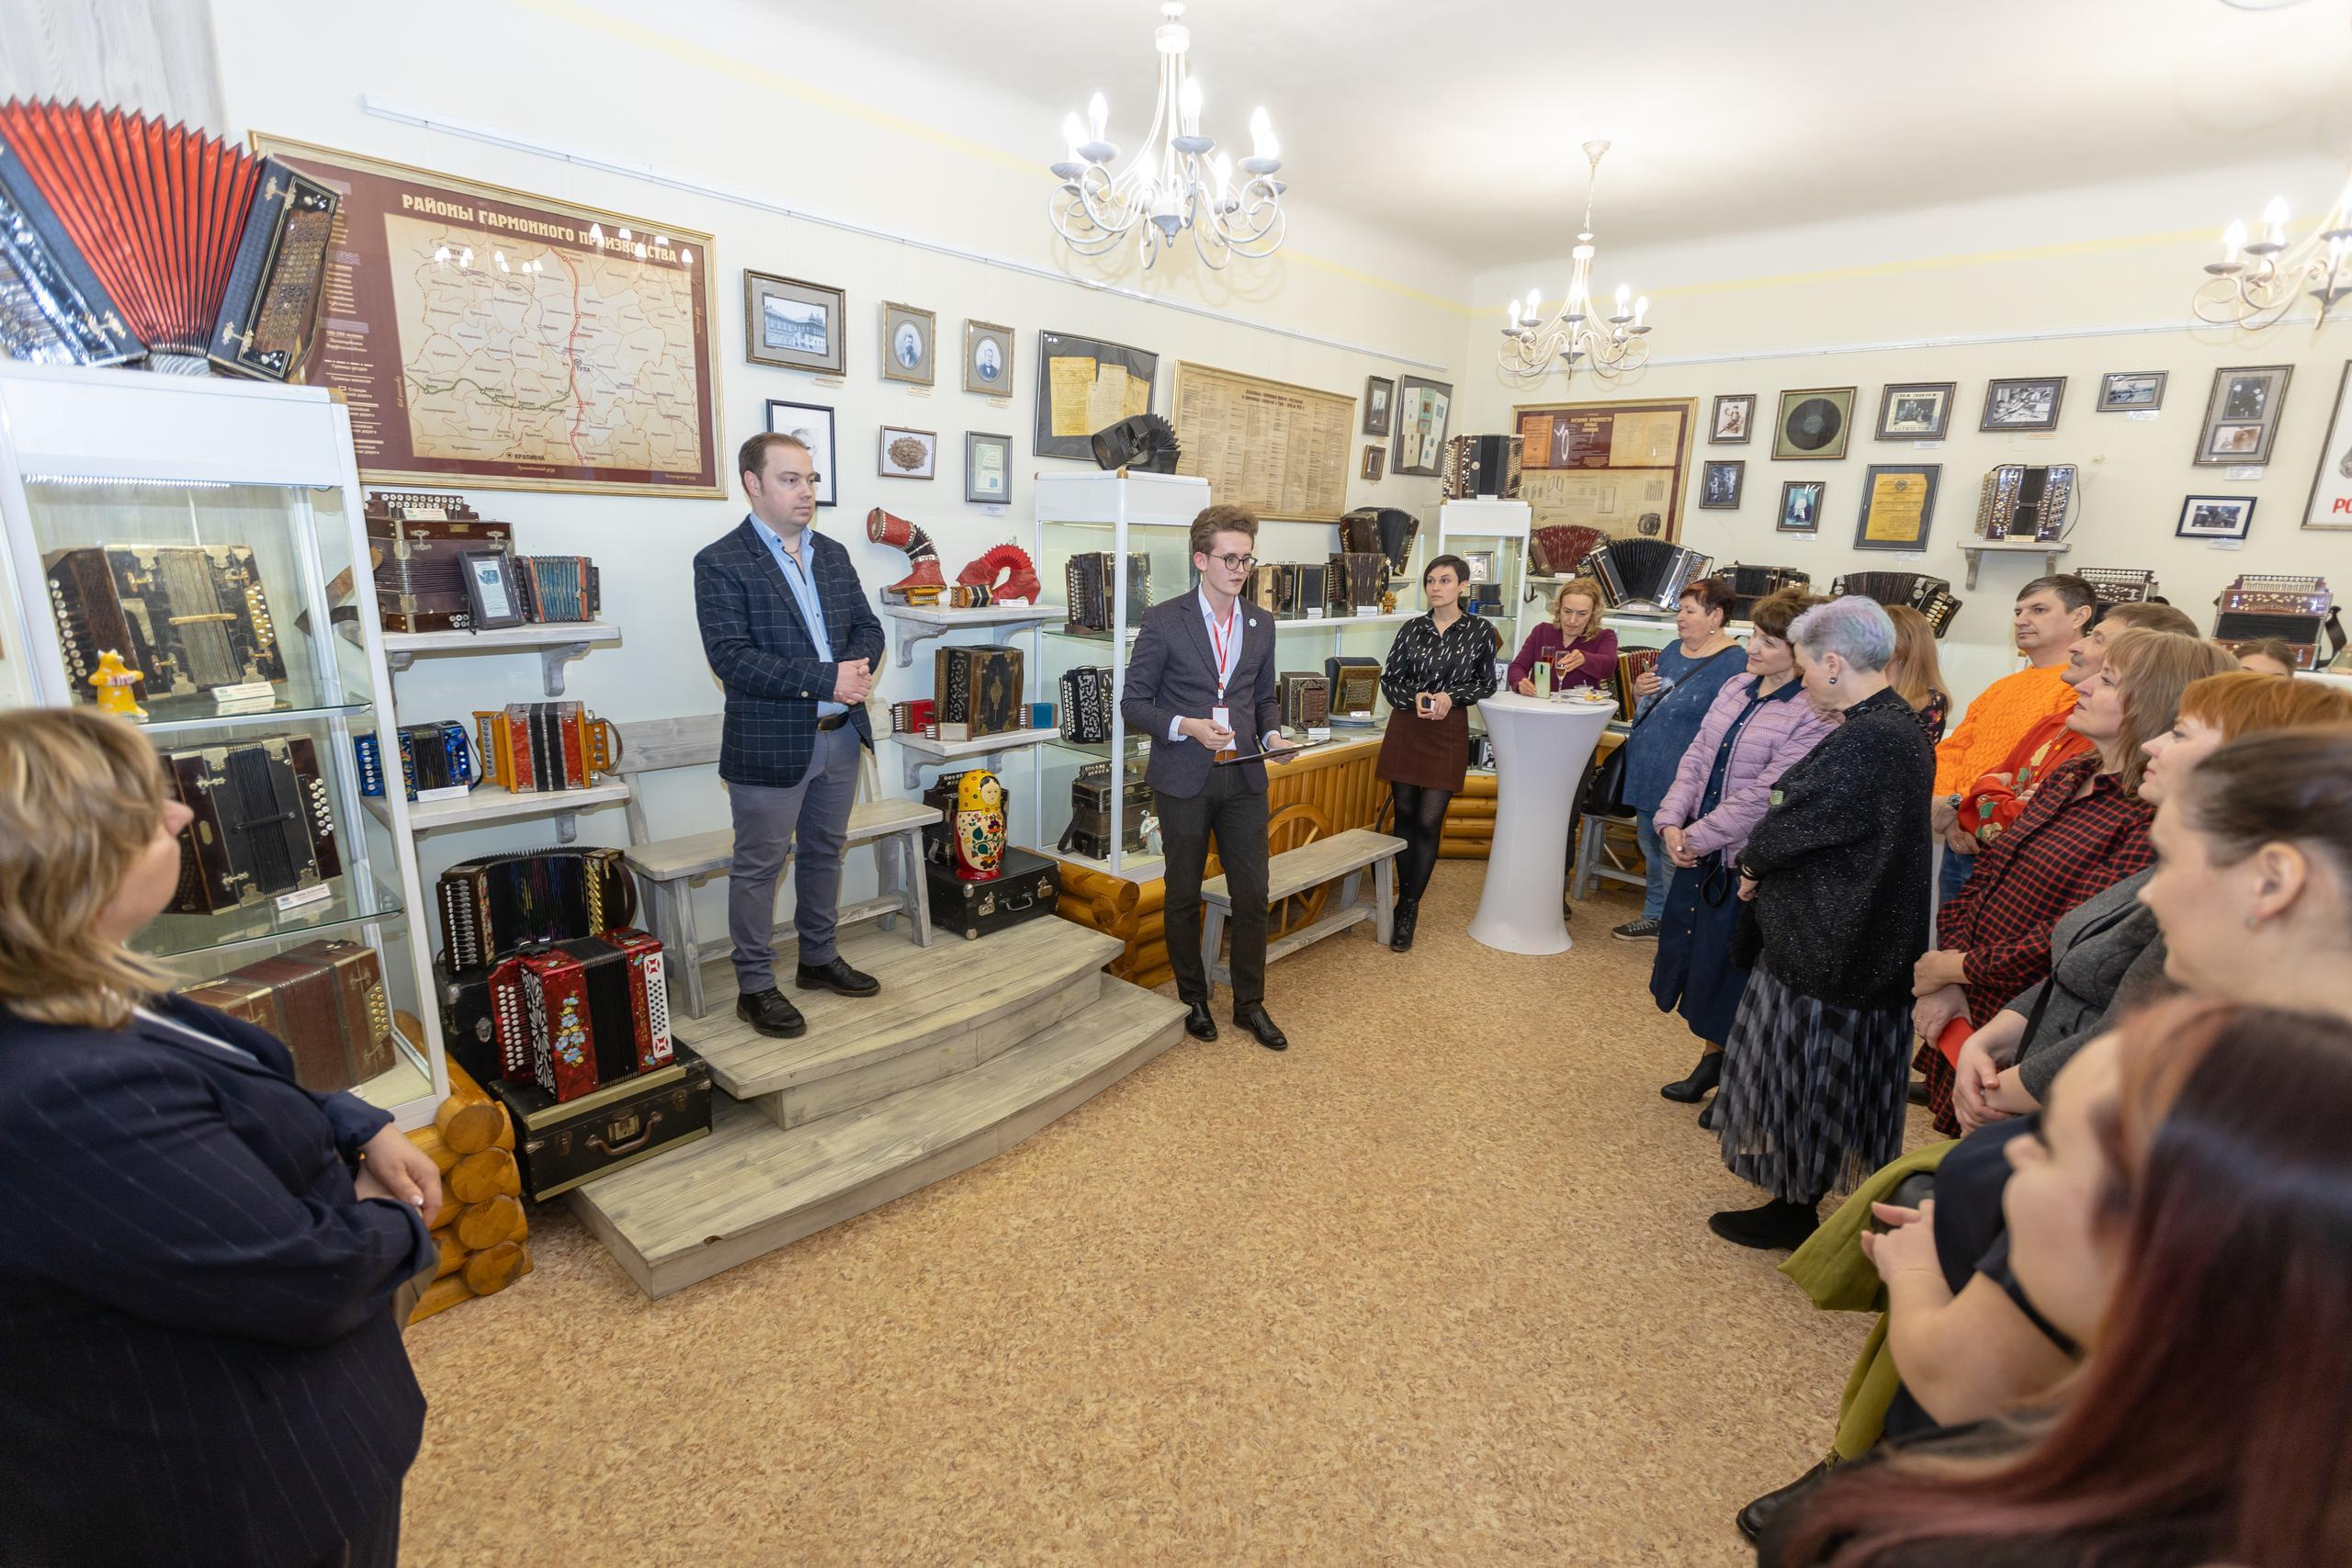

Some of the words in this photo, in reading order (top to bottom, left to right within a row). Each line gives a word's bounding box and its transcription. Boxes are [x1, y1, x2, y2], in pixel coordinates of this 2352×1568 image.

[402, 194, 474, 221] РАЙОНЫ
[479, 210, 574, 242] ГАРМОННОГО
[579, 231, 677, 263] ПРИЗВОСТВА
